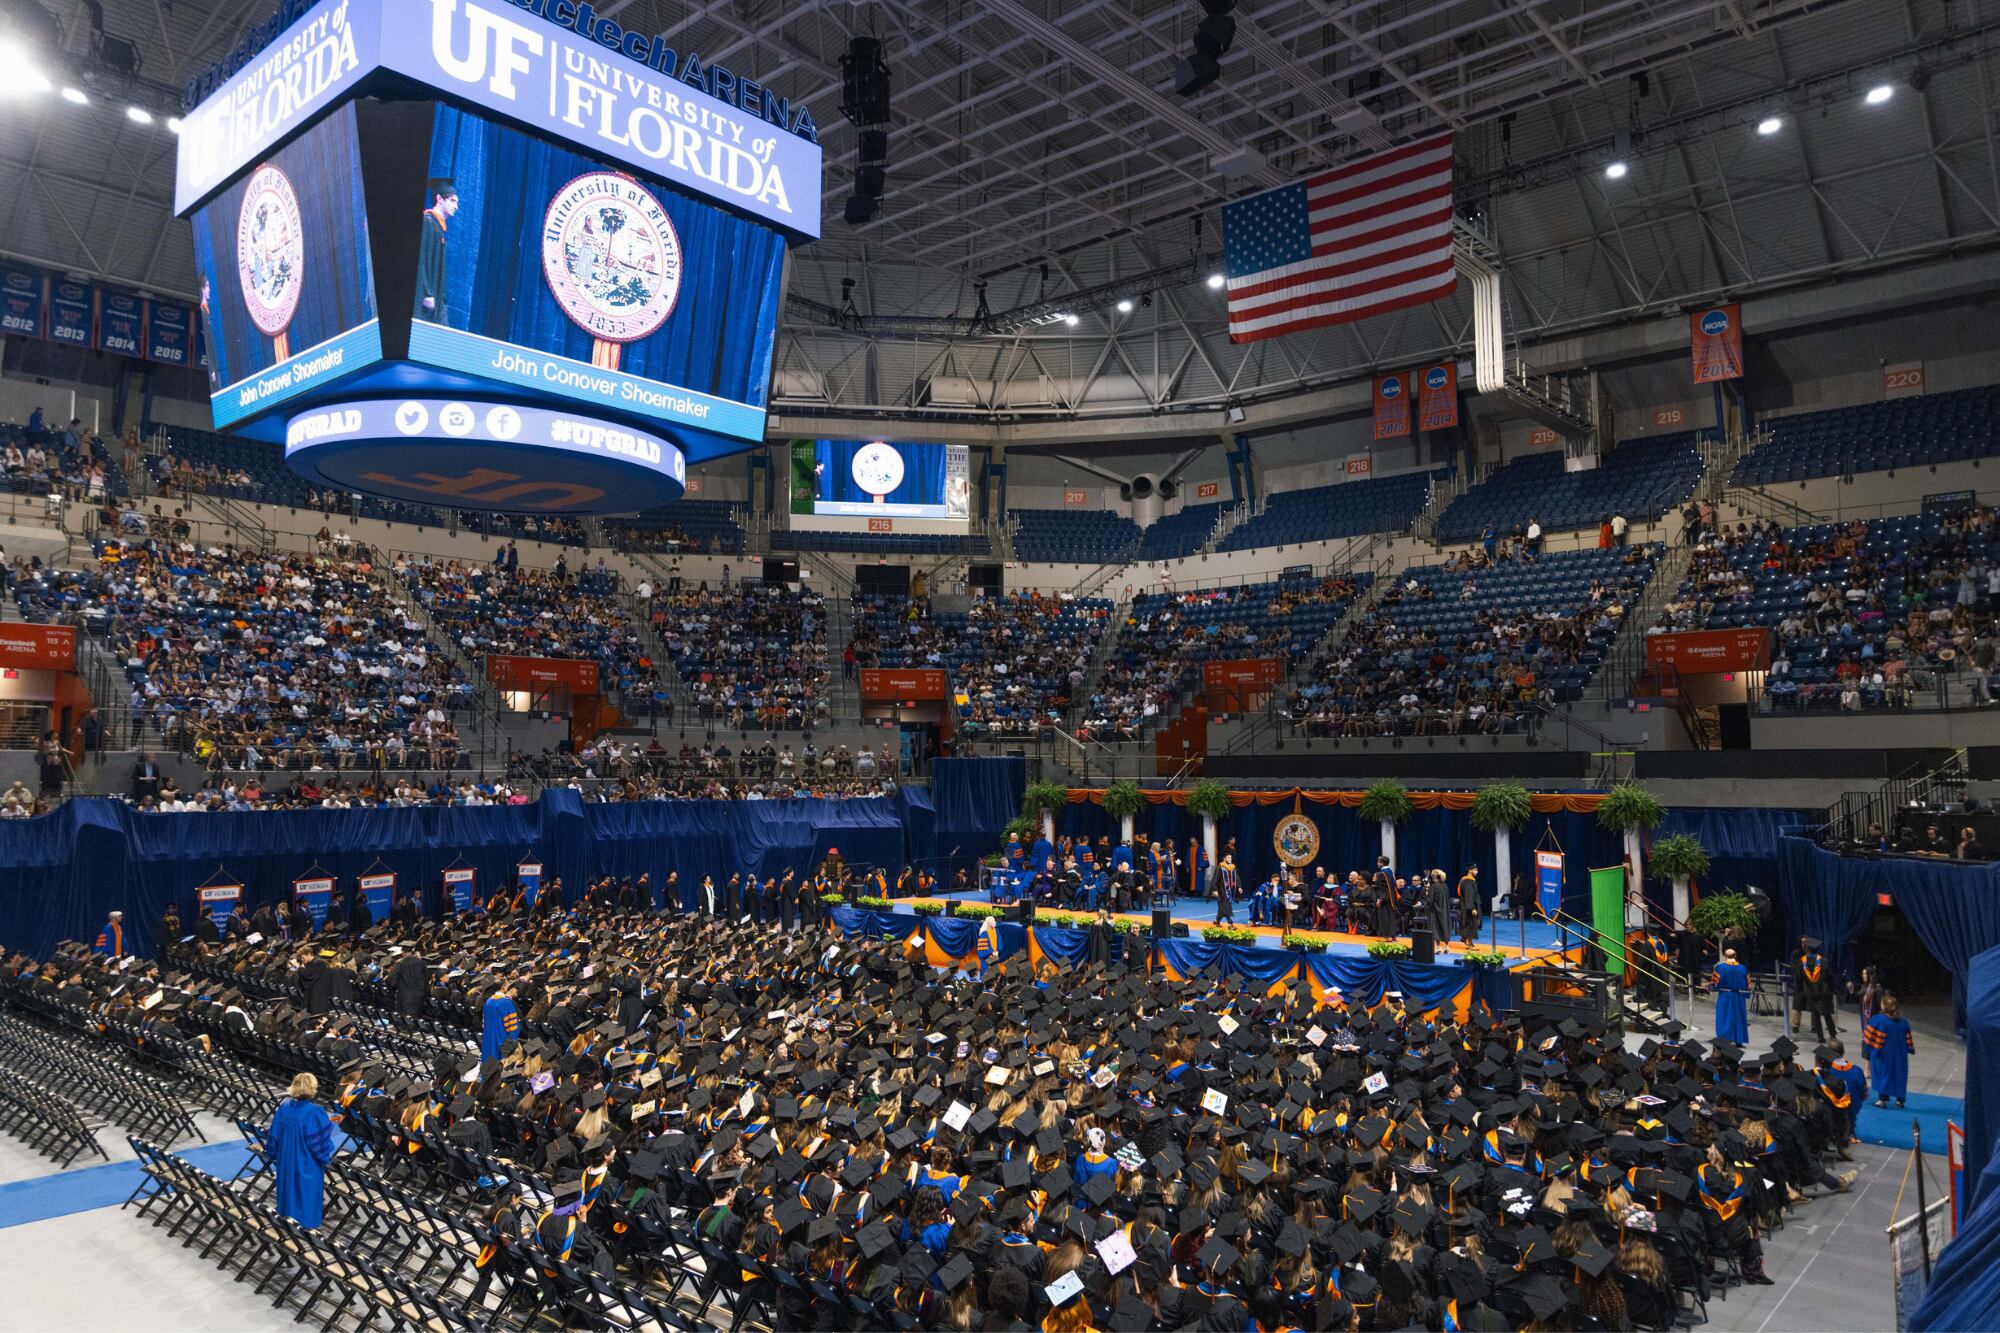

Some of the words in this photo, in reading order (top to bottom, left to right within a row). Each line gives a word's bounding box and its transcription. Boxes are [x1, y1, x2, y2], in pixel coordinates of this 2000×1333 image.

[237, 11, 330, 105] UNIVERSITY
[332, 0, 349, 33] of
[429, 0, 543, 102] UF
[233, 22, 359, 156] FLORIDA
[564, 46, 744, 144] UNIVERSITY
[752, 137, 776, 164] of
[680, 53, 817, 142] ARENA
[563, 74, 793, 214] FLORIDA
[546, 178, 620, 244] University
[628, 190, 647, 206] of
[647, 206, 678, 280] Florida
[2, 315, 34, 331] 2012
[54, 325, 86, 341] 2013
[106, 336, 135, 351] 2014
[154, 346, 183, 360] 2015
[239, 386, 258, 407] John
[258, 371, 292, 398] Conover
[293, 348, 344, 383] Shoemaker
[491, 350, 538, 377] John
[543, 362, 617, 396] Conover
[620, 381, 711, 418] Shoemaker
[1888, 371, 1921, 388] 220
[1658, 410, 1681, 424] 219
[551, 419, 661, 464] #UFGRAD
[1533, 430, 1555, 444] 219
[1350, 460, 1368, 473] 218
[686, 481, 698, 491] 15
[1200, 485, 1215, 496] 217
[1067, 493, 1084, 502] 217
[871, 520, 890, 531] 216
[6, 645, 36, 653] ARENA
